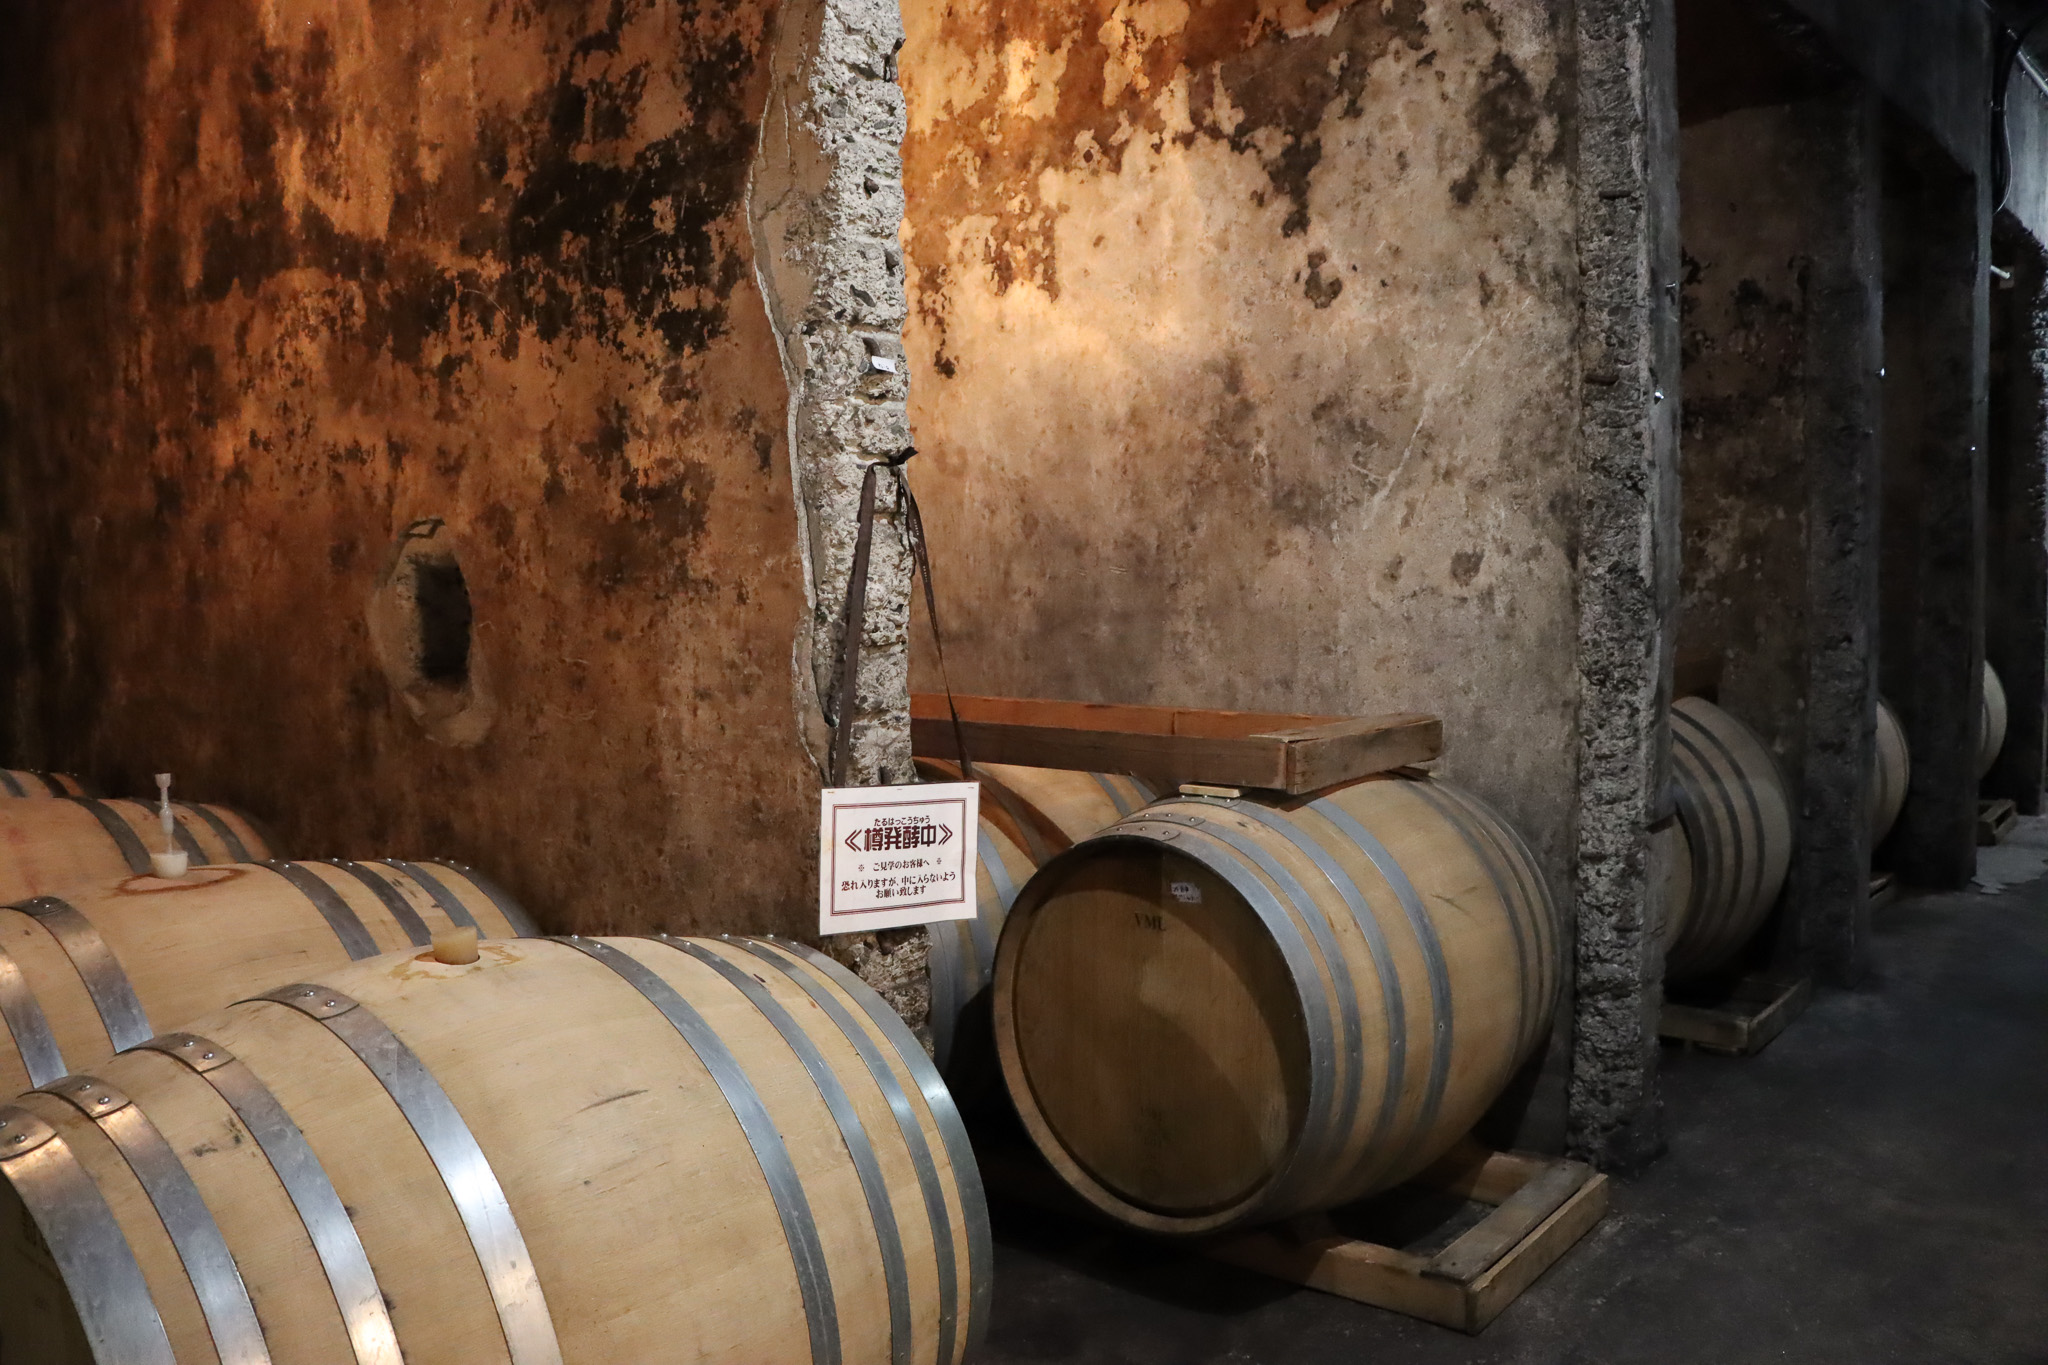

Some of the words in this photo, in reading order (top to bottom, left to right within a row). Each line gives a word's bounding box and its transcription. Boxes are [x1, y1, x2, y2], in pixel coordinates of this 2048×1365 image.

[874, 816, 931, 827] たるはっこうちゅう
[872, 859, 930, 872] ご見学のお客様へ
[875, 886, 927, 899] お願い致します
